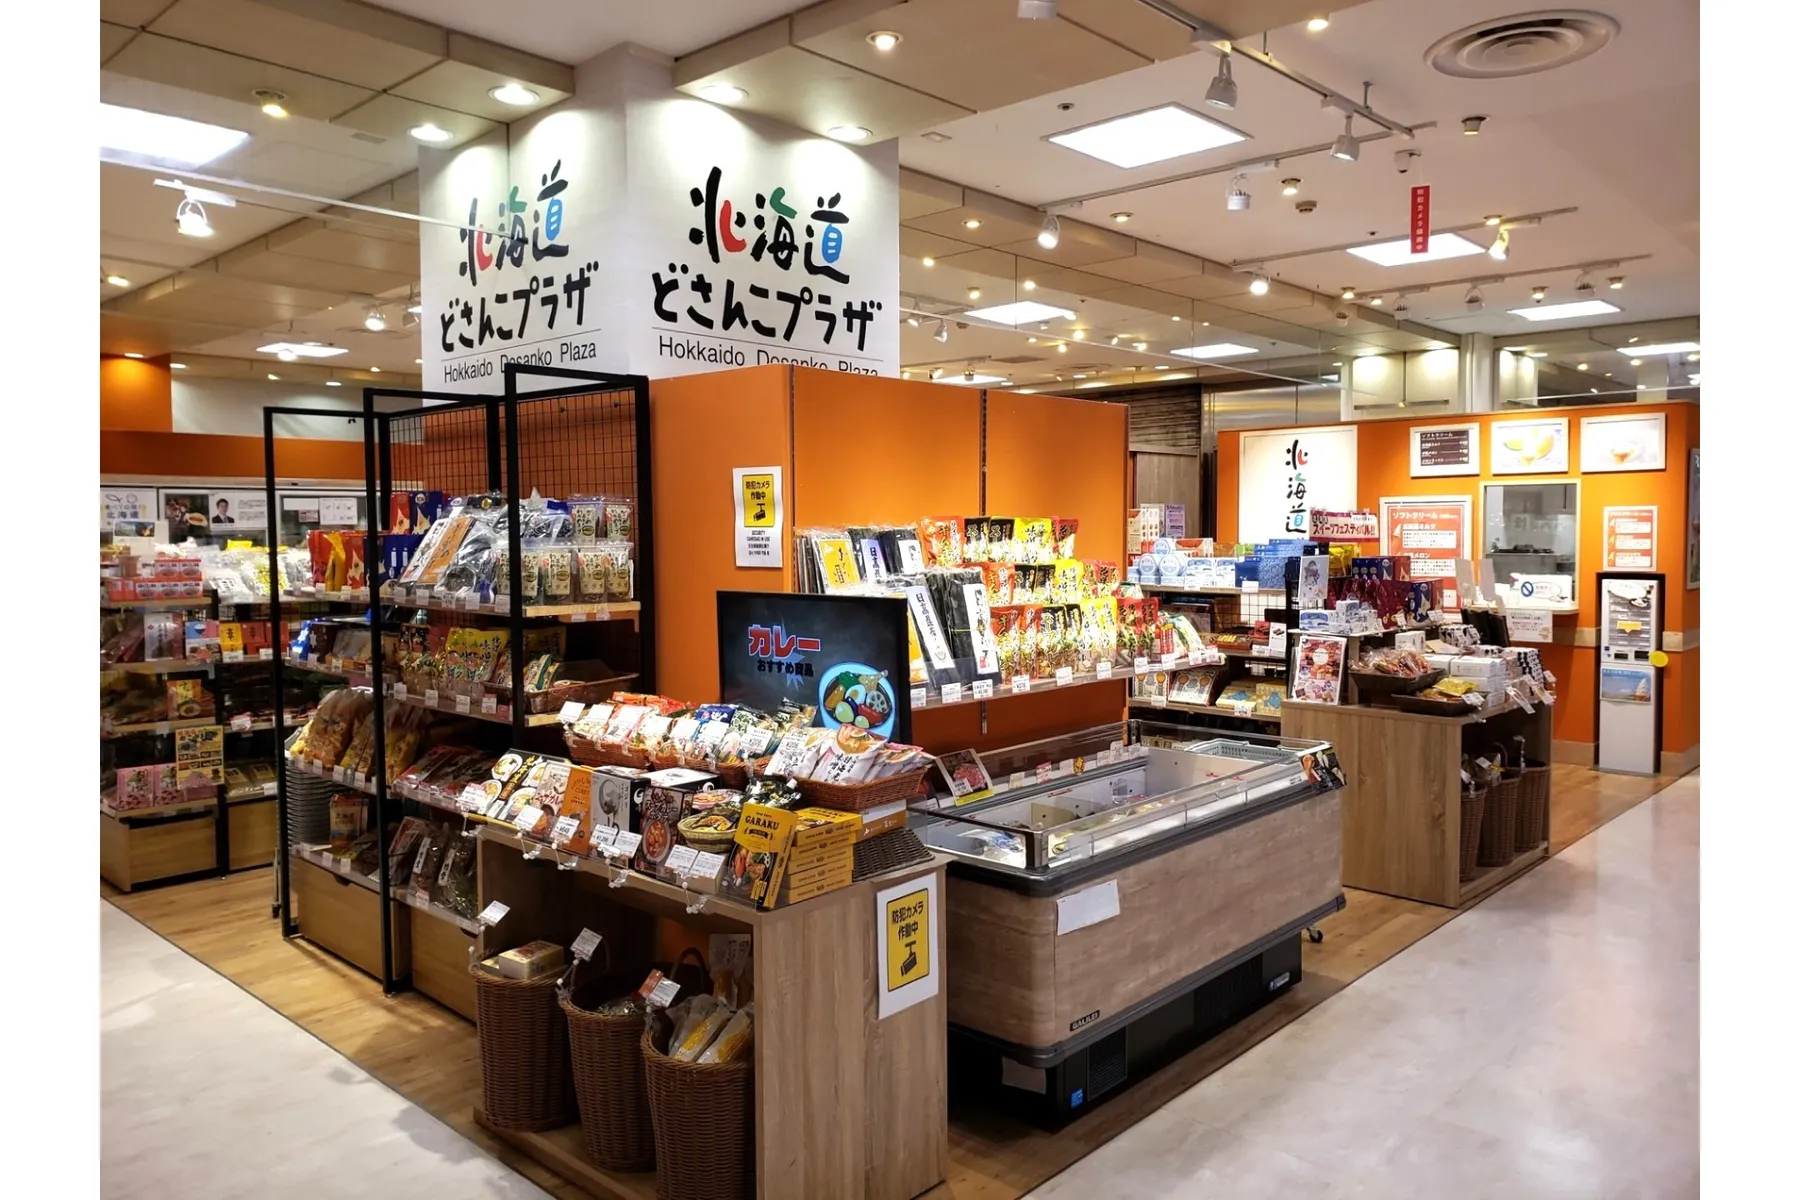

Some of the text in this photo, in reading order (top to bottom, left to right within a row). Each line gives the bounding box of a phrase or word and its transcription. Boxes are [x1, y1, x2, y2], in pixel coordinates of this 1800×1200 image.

[459, 159, 569, 287] 北海道
[689, 165, 850, 285] 北海道
[440, 261, 600, 353] どさんこプラザ
[651, 262, 884, 352] どさんこプラザ
[444, 359, 493, 383] Hokkaido
[560, 341, 597, 363] Plaza
[658, 335, 745, 366] Hokkaido
[746, 481, 770, 489] 防犯カメラ
[751, 491, 766, 500] 作動中
[1285, 439, 1309, 534] 北海道
[1392, 511, 1438, 519] ソフトクリーム
[747, 623, 821, 659] カレー
[757, 659, 814, 678] おすすめ商品
[744, 815, 780, 831] GARAKU
[891, 901, 924, 924] 防犯カメラ
[898, 920, 919, 941] 作動中
